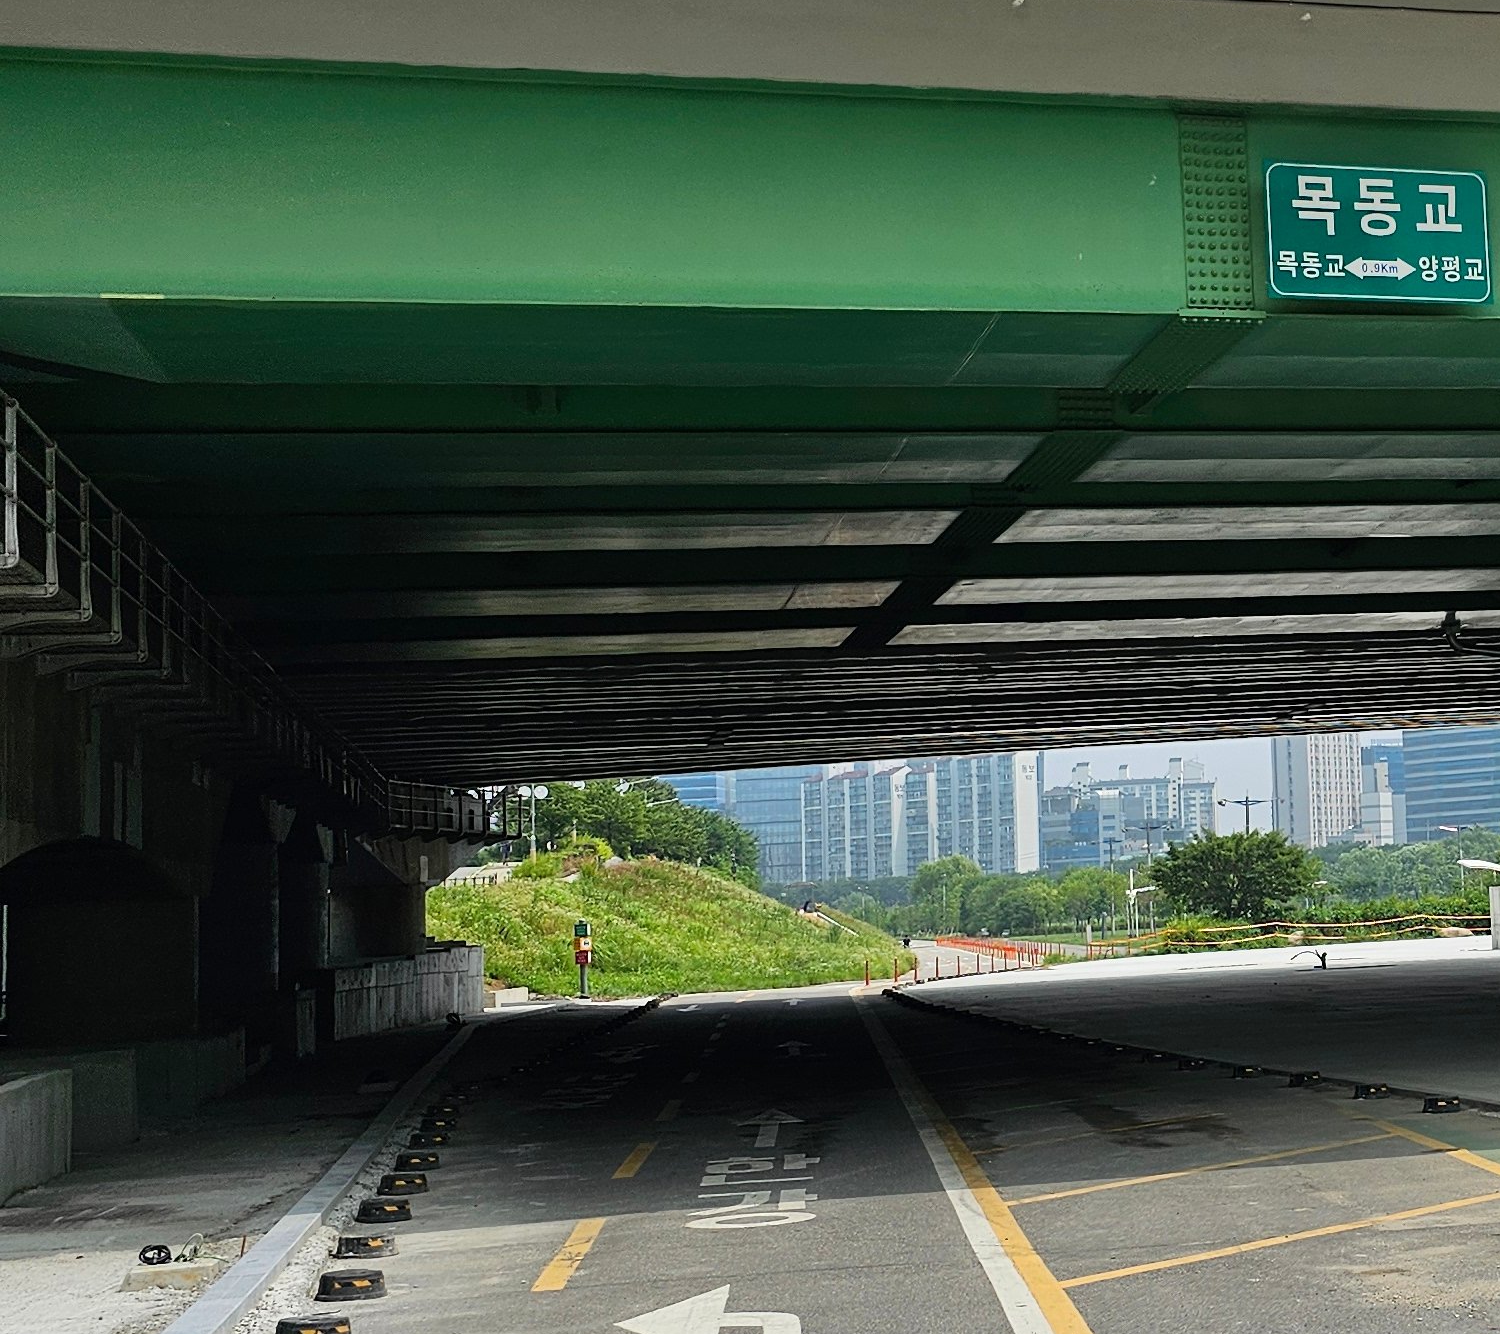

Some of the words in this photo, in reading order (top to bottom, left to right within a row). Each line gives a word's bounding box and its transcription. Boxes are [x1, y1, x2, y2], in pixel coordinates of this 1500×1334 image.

[1291, 174, 1463, 236] 목동교
[1276, 250, 1346, 278] 목동교
[1361, 262, 1399, 275] 0.9Km
[1418, 255, 1485, 282] 양평교
[683, 1152, 821, 1229] 한강
